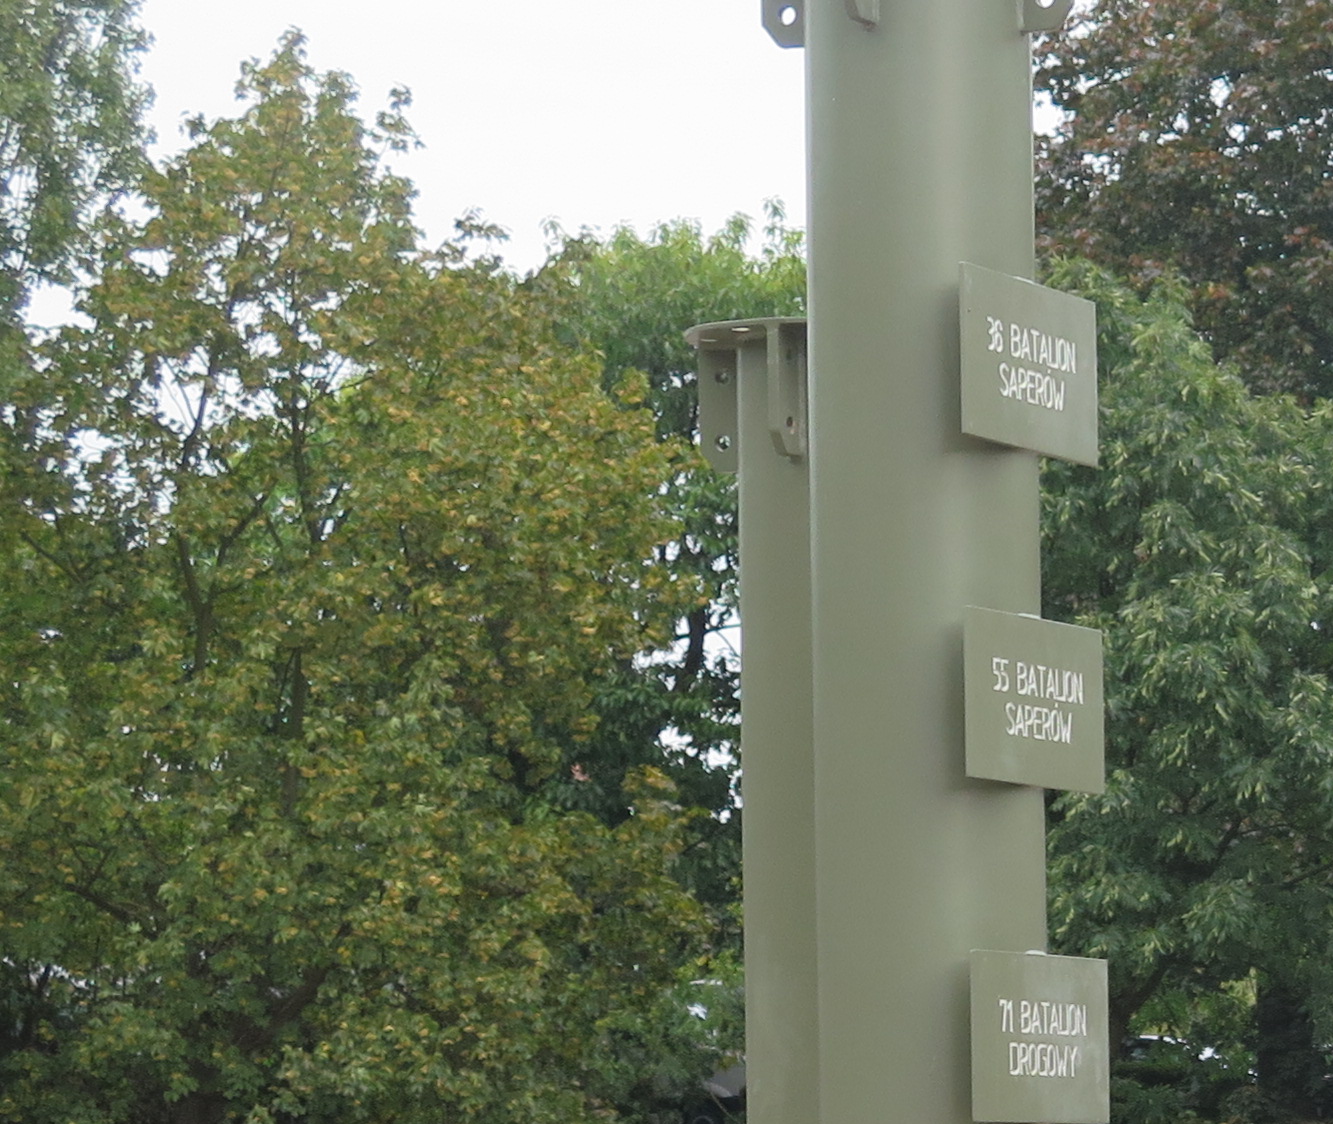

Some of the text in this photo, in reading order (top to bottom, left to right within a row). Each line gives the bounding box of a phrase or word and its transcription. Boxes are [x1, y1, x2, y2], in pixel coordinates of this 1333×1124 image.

[986, 315, 1076, 375] 36 BATALION
[999, 358, 1064, 412] SAPERÓW
[991, 656, 1084, 703] 55 BATALION
[1005, 701, 1073, 745] SAPERÓW
[999, 998, 1086, 1036] 71 BATALION
[1009, 1043, 1080, 1078] DROGOWY
